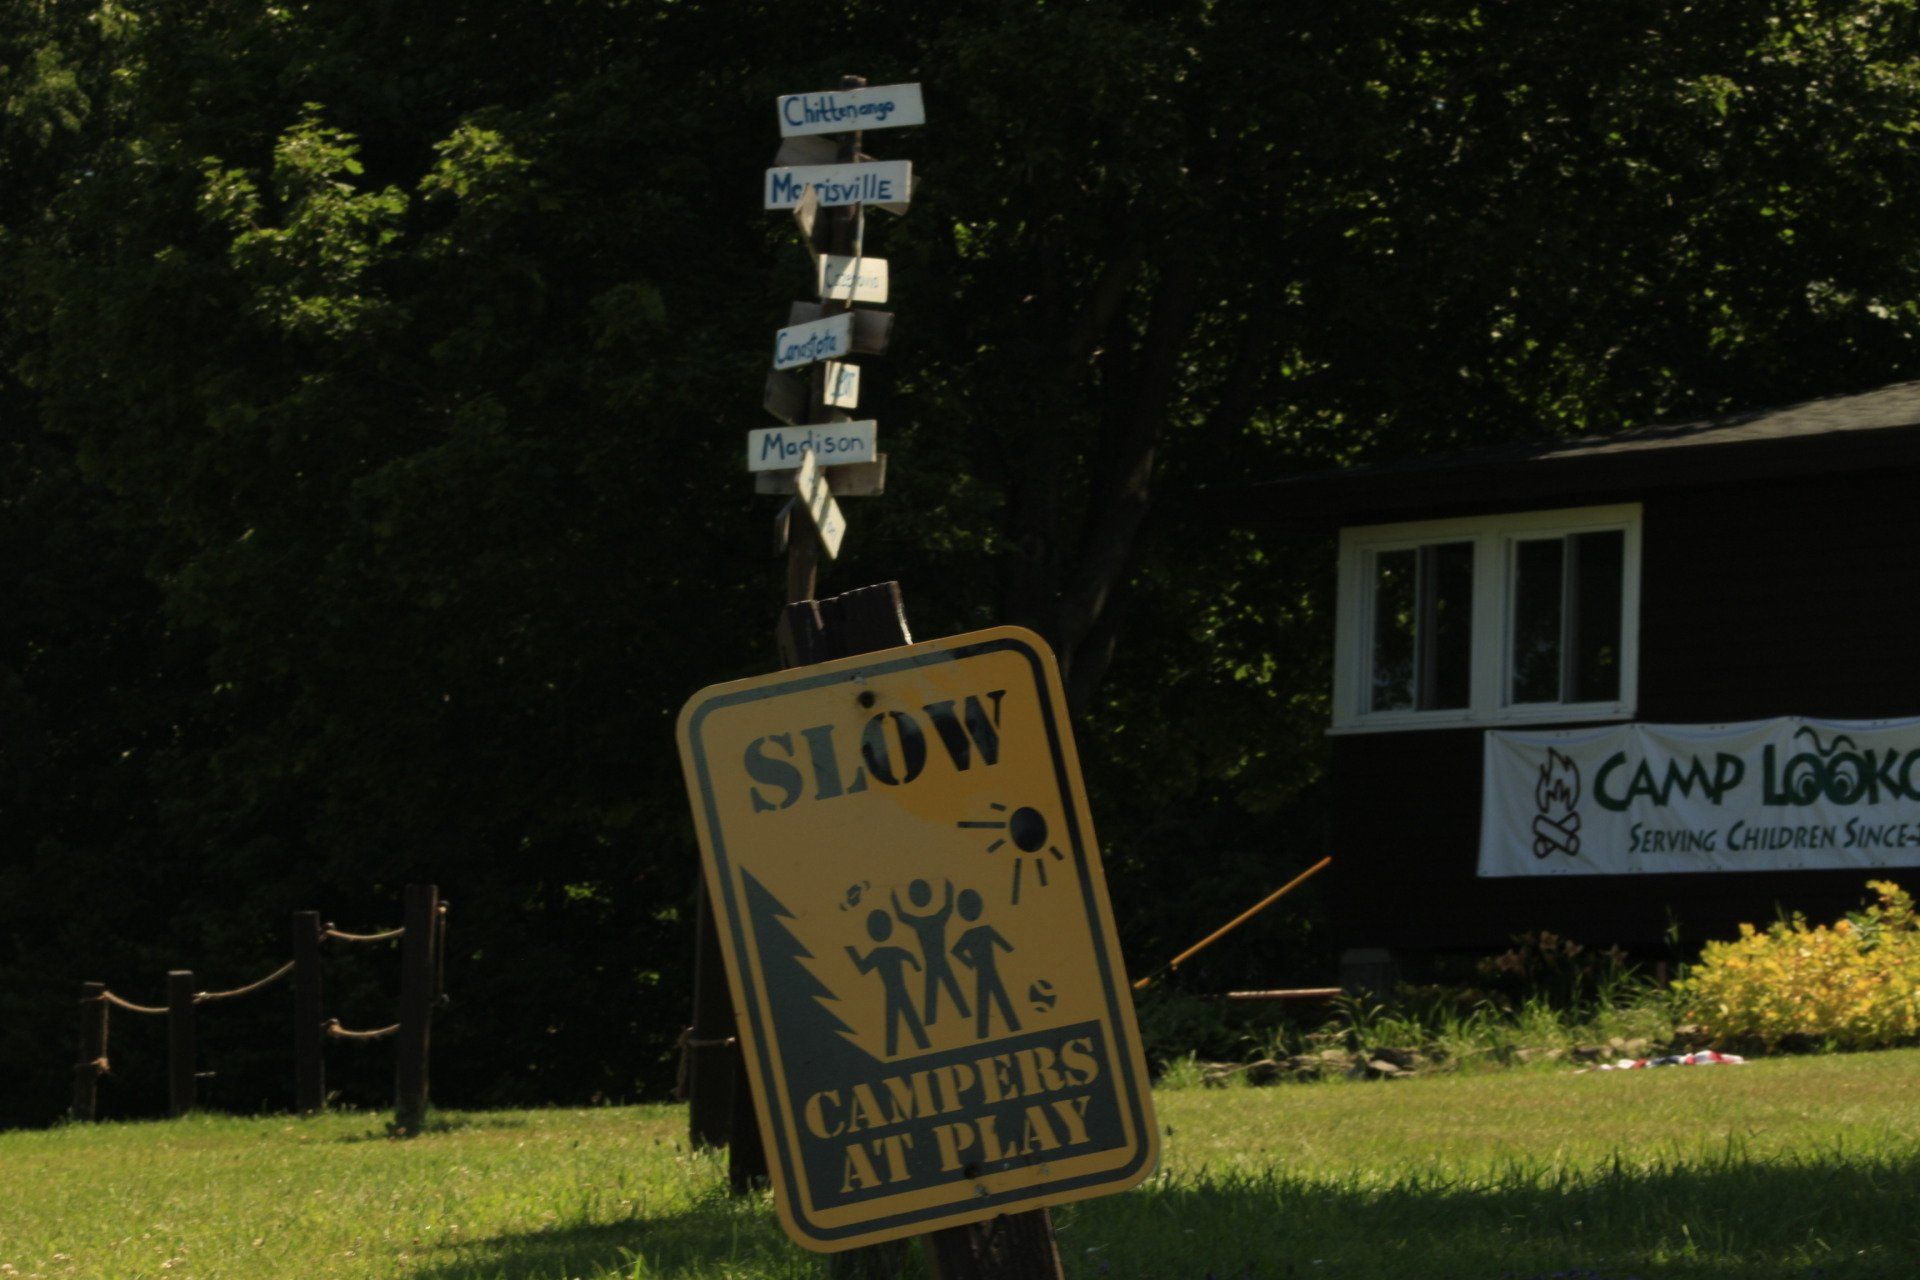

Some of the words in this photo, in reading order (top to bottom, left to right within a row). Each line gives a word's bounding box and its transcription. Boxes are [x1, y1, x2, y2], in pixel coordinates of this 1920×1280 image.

[784, 96, 895, 126] Chittenango
[761, 430, 864, 460] Madison
[744, 690, 1006, 812] SLOW
[1594, 752, 1745, 811] CAMP
[1628, 822, 1717, 853] SERVING
[1727, 820, 1836, 850] CHILDREN
[805, 1036, 1099, 1140] CAMPERS
[840, 1130, 917, 1194] AT
[932, 1096, 1092, 1175] PLAY
